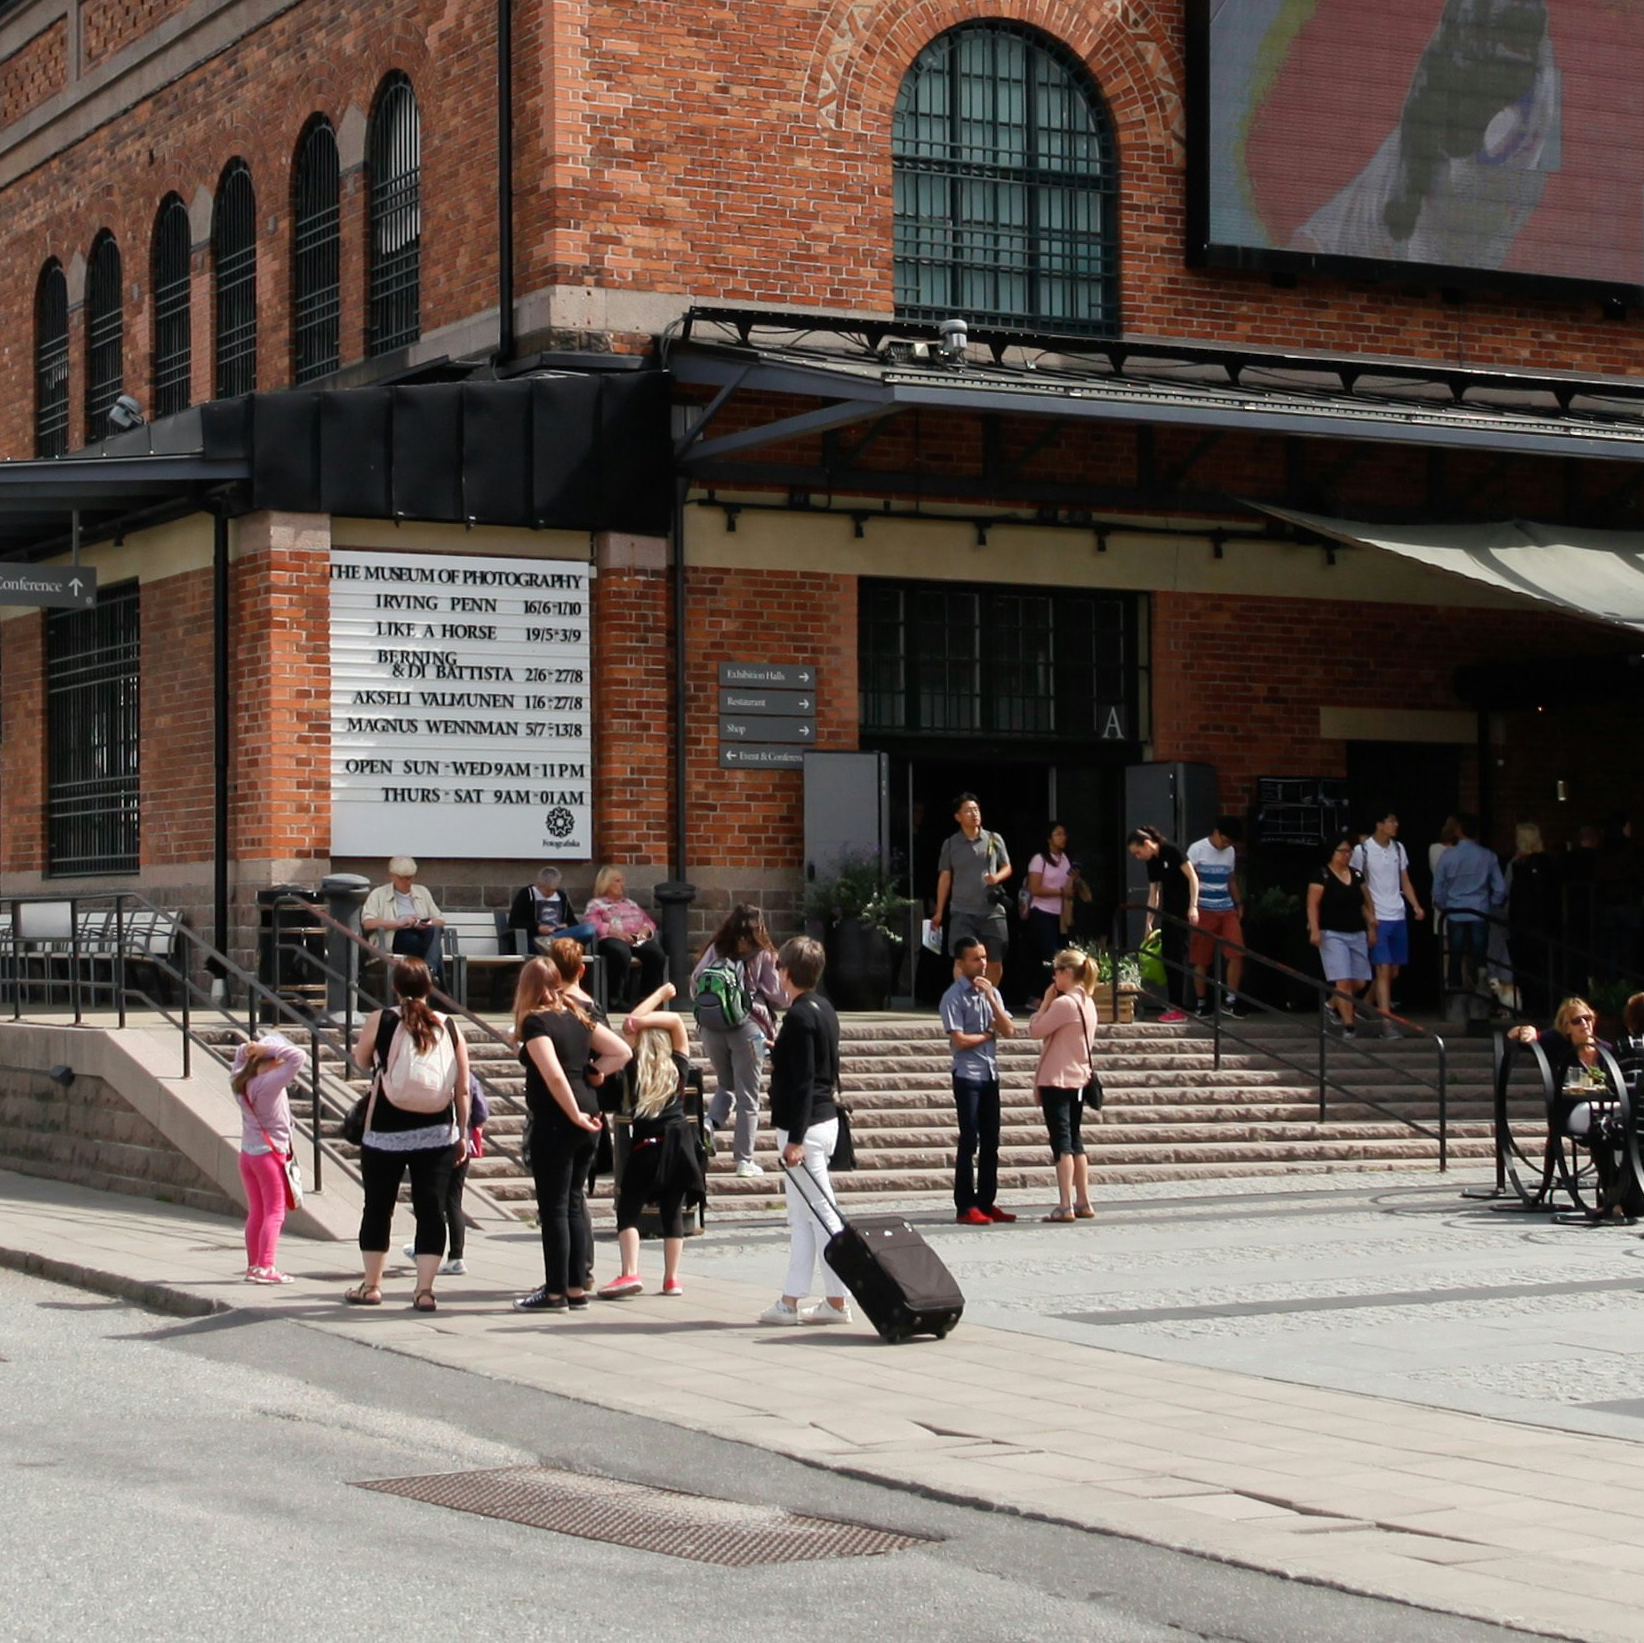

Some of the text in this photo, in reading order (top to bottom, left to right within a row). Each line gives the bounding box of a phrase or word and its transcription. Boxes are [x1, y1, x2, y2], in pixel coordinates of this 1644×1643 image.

[329, 564, 582, 589] THE MUSEUM OF PHOTOGRAPHY
[376, 594, 438, 611] IRVING
[450, 597, 497, 613] PENN
[376, 622, 415, 637] LIKE
[424, 624, 435, 637] A
[441, 624, 497, 640] HORSE
[377, 649, 458, 666] BERNING
[392, 661, 405, 678] &
[408, 662, 426, 678] DI
[436, 664, 513, 681] BATTISTA
[353, 690, 411, 706] AKSELI
[419, 692, 514, 708] VALMUNEN
[347, 718, 418, 734] MAGNUS
[425, 720, 519, 736] WENNMAN
[1102, 706, 1125, 739] A
[345, 759, 393, 774] OPEN
[381, 787, 441, 803] THURS
[454, 789, 484, 804] SAT
[542, 839, 580, 850] Fotografiska
